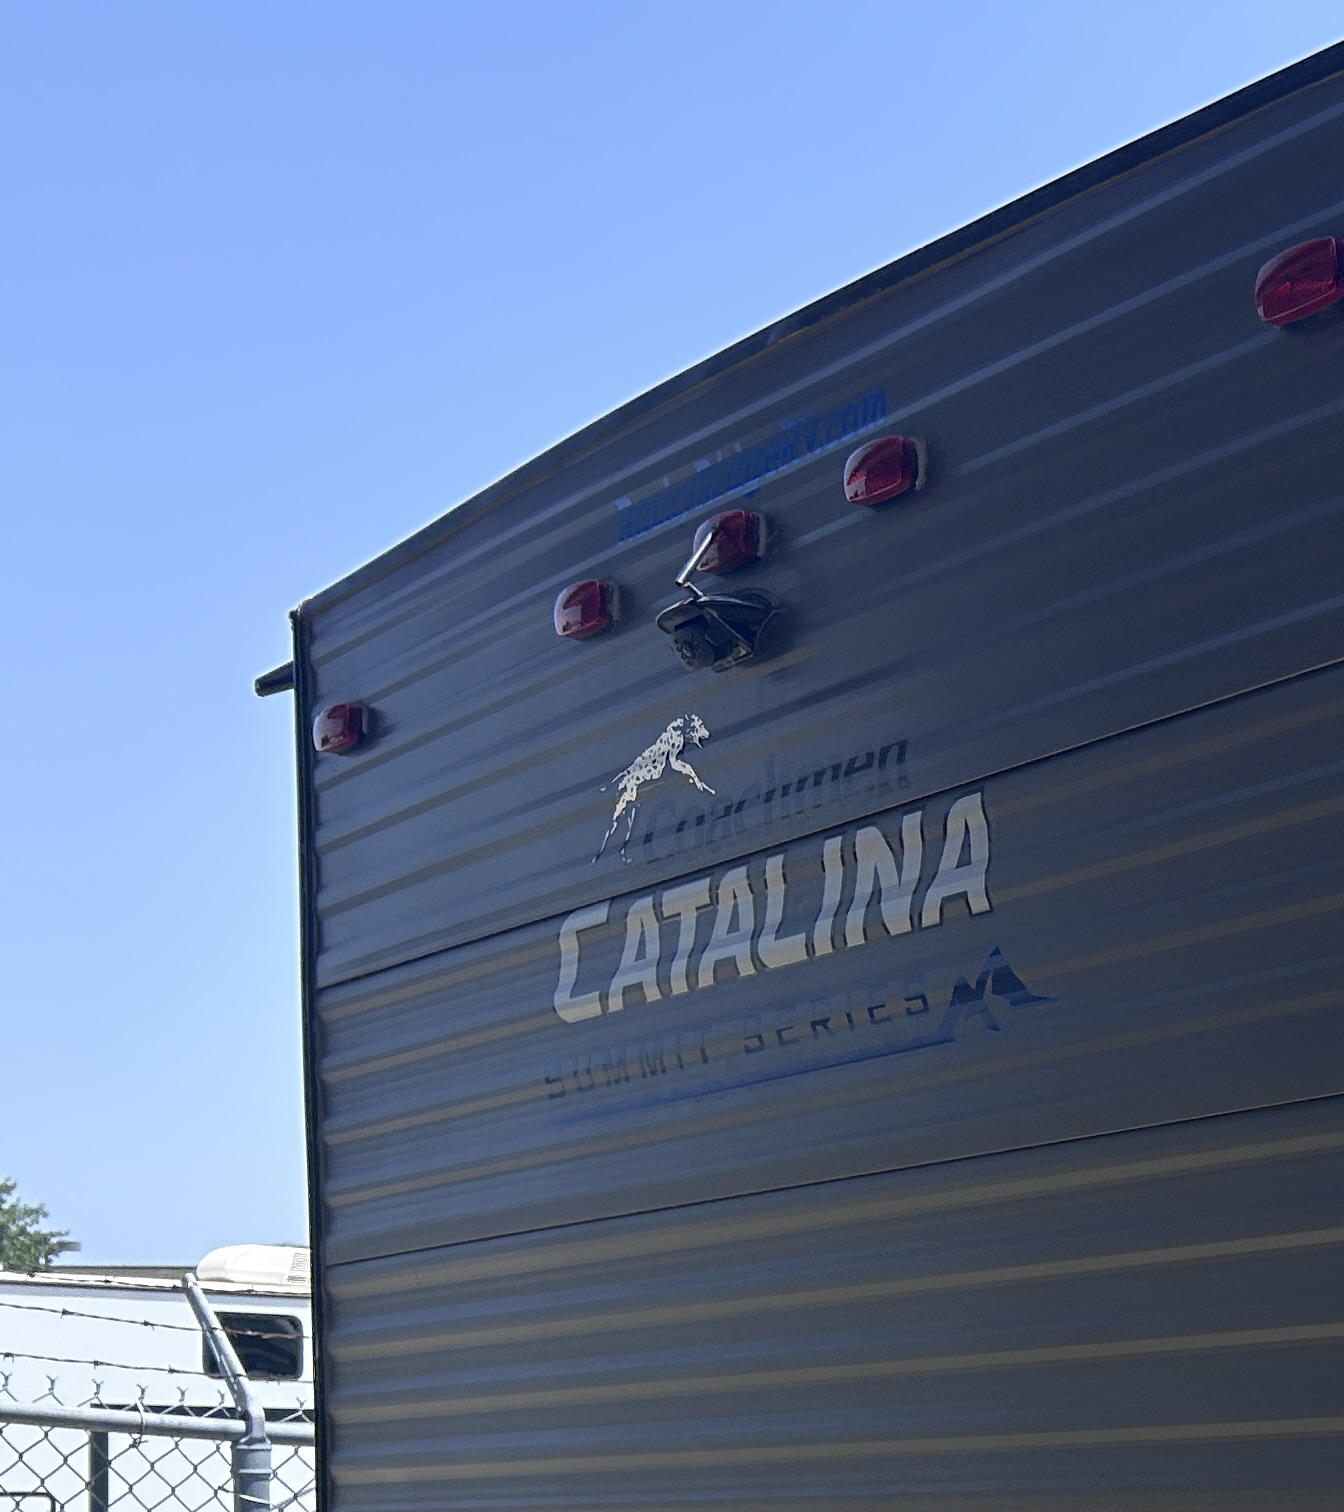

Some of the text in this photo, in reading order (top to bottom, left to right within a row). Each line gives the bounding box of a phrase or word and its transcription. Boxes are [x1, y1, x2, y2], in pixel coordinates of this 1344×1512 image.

[642, 739, 913, 866] Coachmen
[553, 790, 994, 1025] CATALINA
[543, 973, 930, 1100] SUMMIT SERIES
